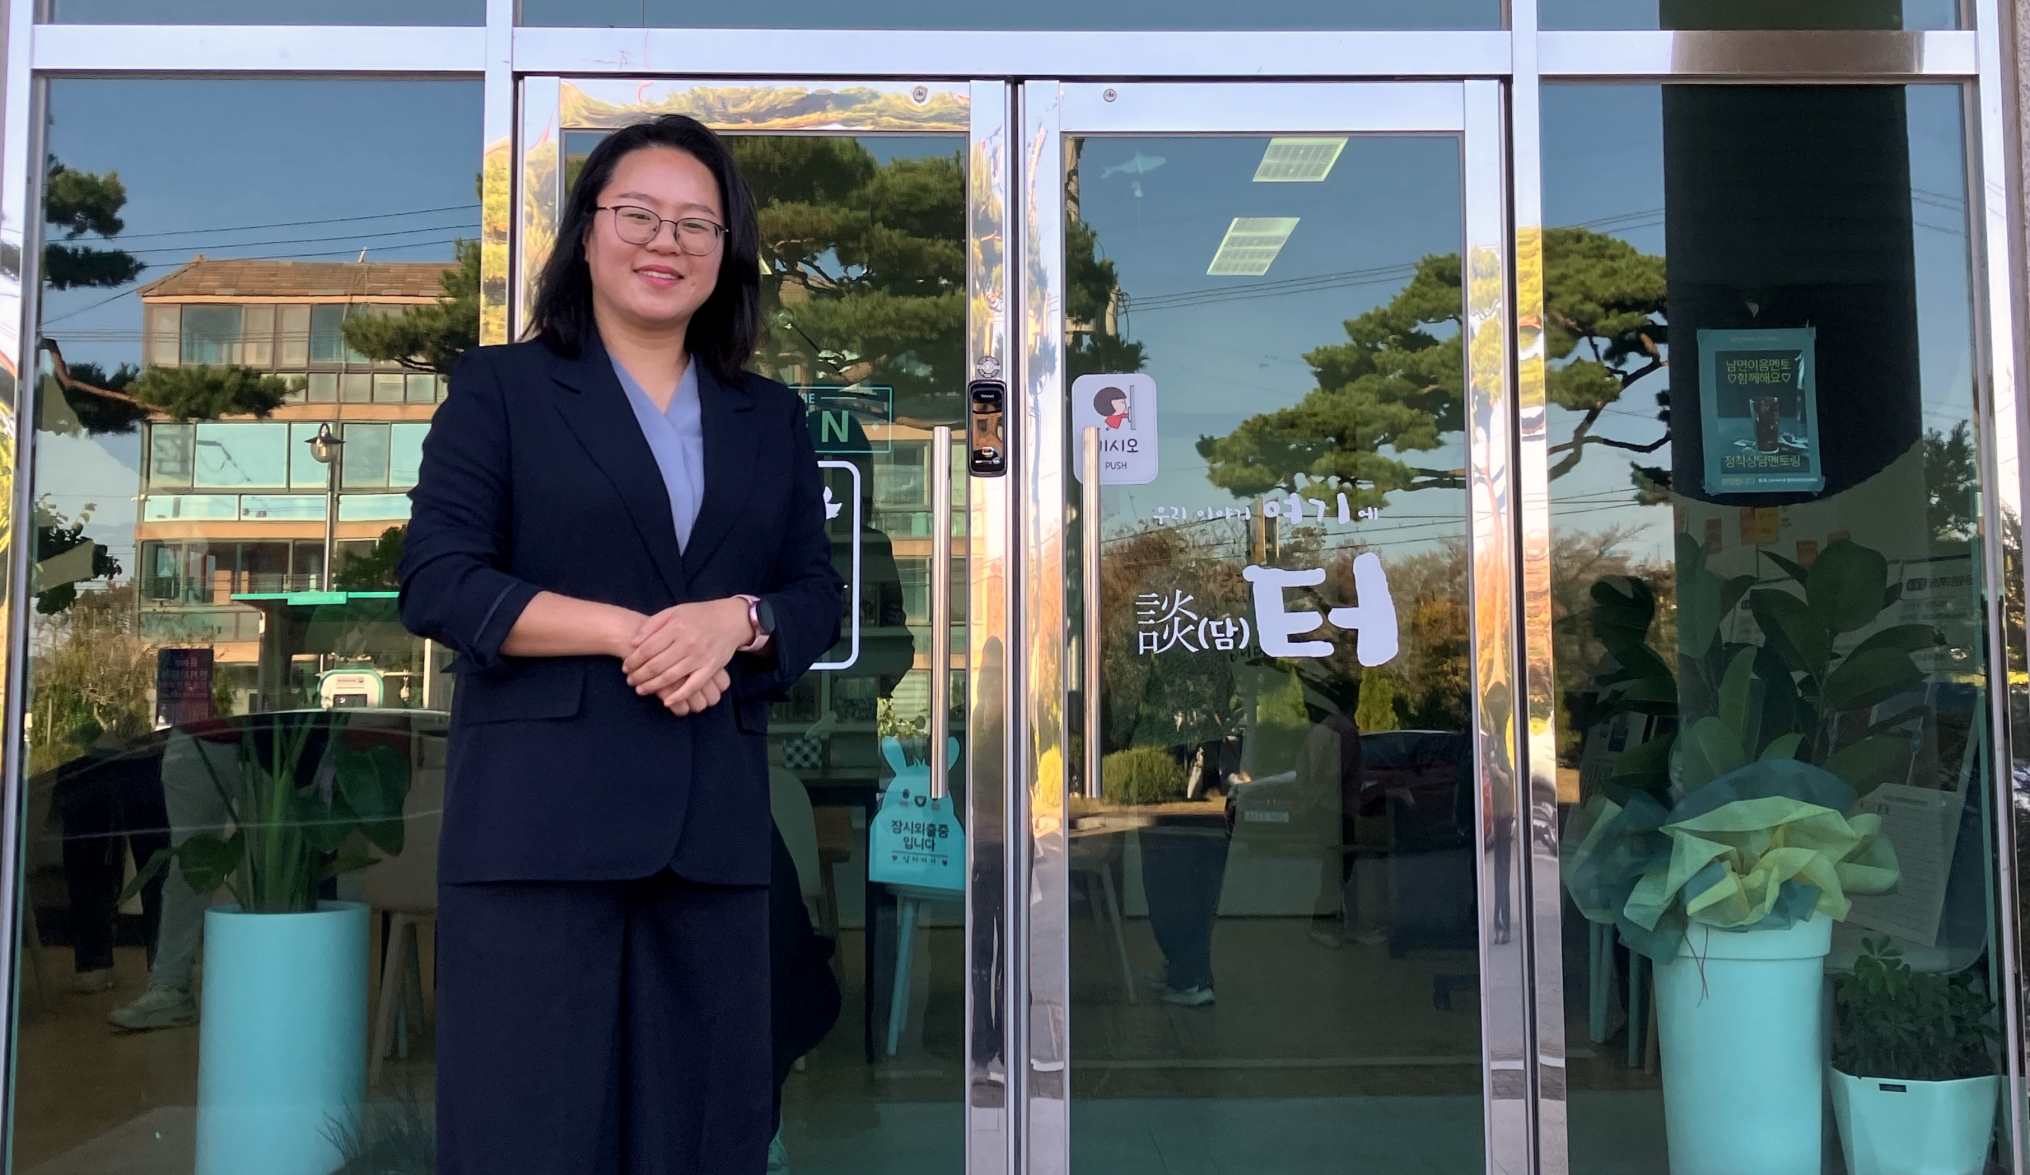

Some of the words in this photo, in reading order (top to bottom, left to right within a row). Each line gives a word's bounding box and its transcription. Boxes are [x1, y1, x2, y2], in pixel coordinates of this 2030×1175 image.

[1738, 371, 1781, 385] 함께해요
[1105, 461, 1127, 470] PUSH
[1724, 454, 1801, 468] 정착상담멘토링
[1153, 506, 1187, 525] 우리
[1197, 506, 1250, 520] 이야기
[891, 820, 949, 839] 잠시외출중
[903, 837, 935, 851] 입니다
